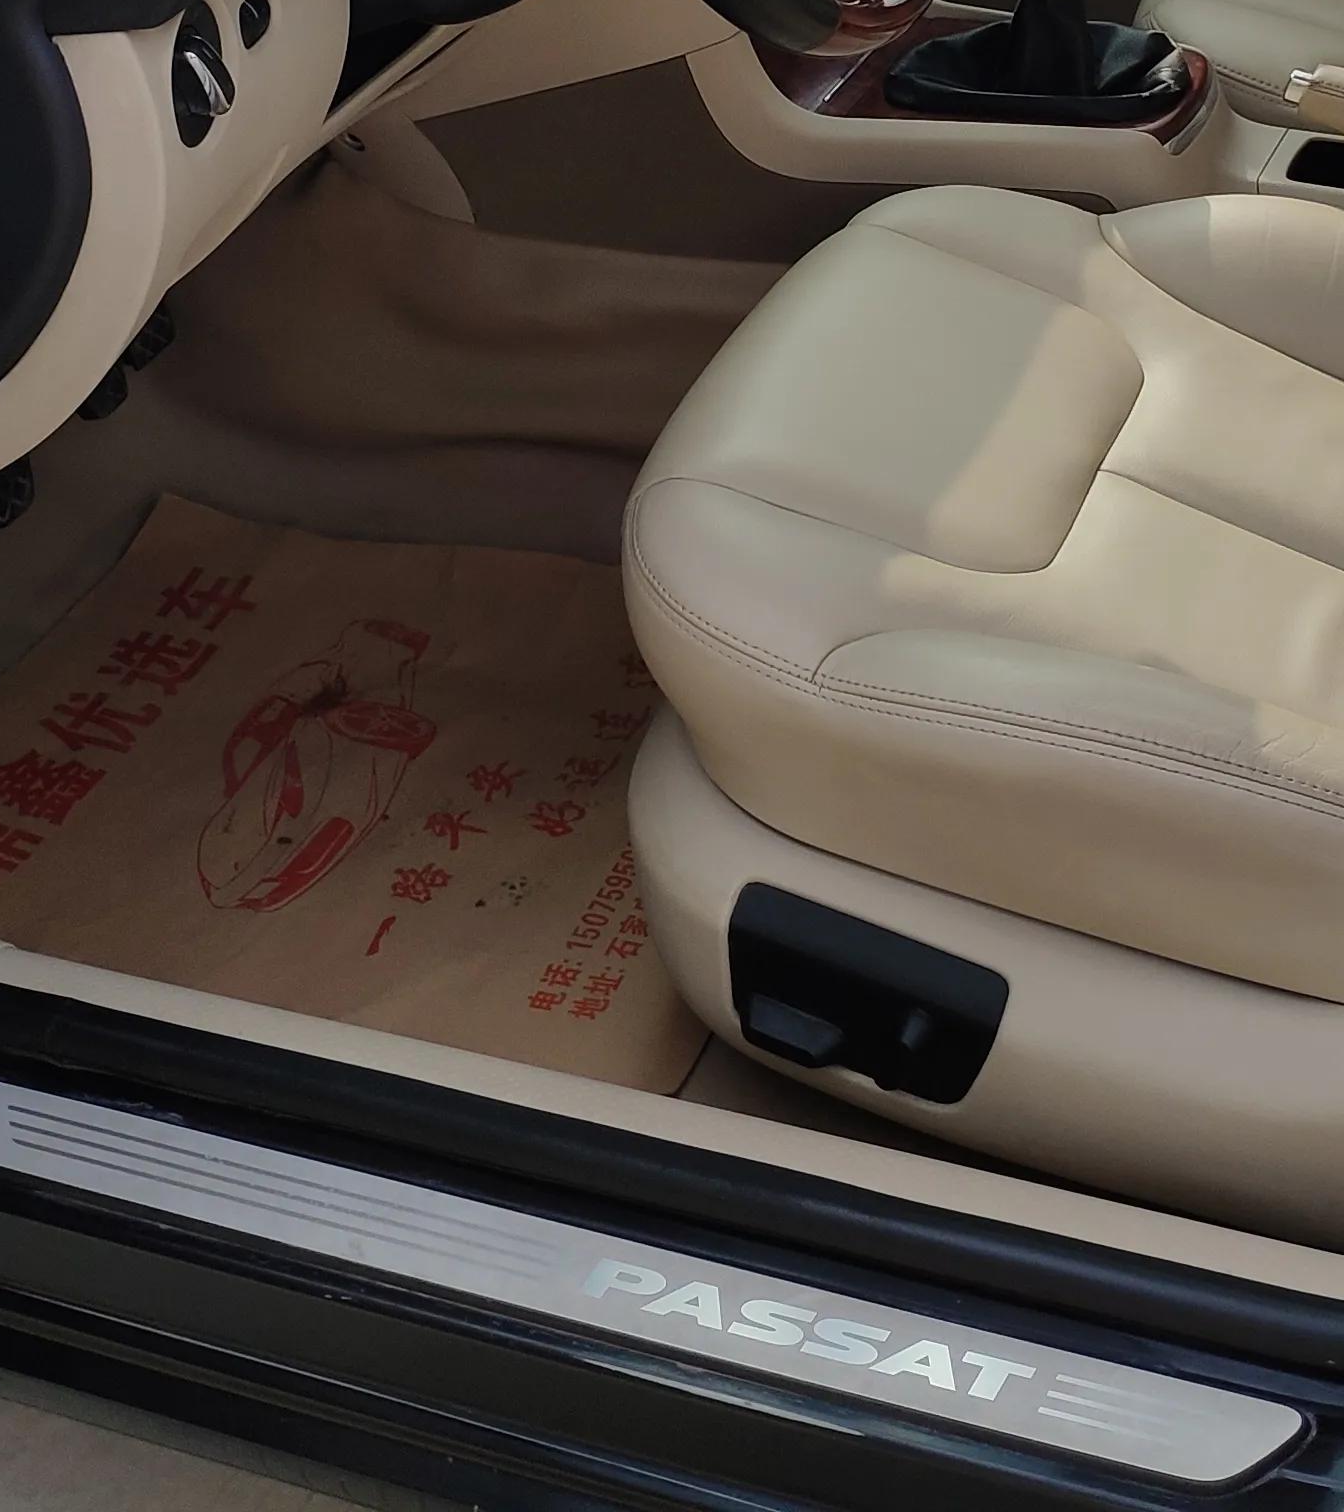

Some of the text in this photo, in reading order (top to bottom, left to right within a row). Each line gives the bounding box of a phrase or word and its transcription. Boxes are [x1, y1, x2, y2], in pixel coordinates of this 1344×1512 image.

[365, 760, 528, 956] 一路平安
[568, 897, 649, 1020] 地址:石家
[583, 1257, 1037, 1402] PASSAT
